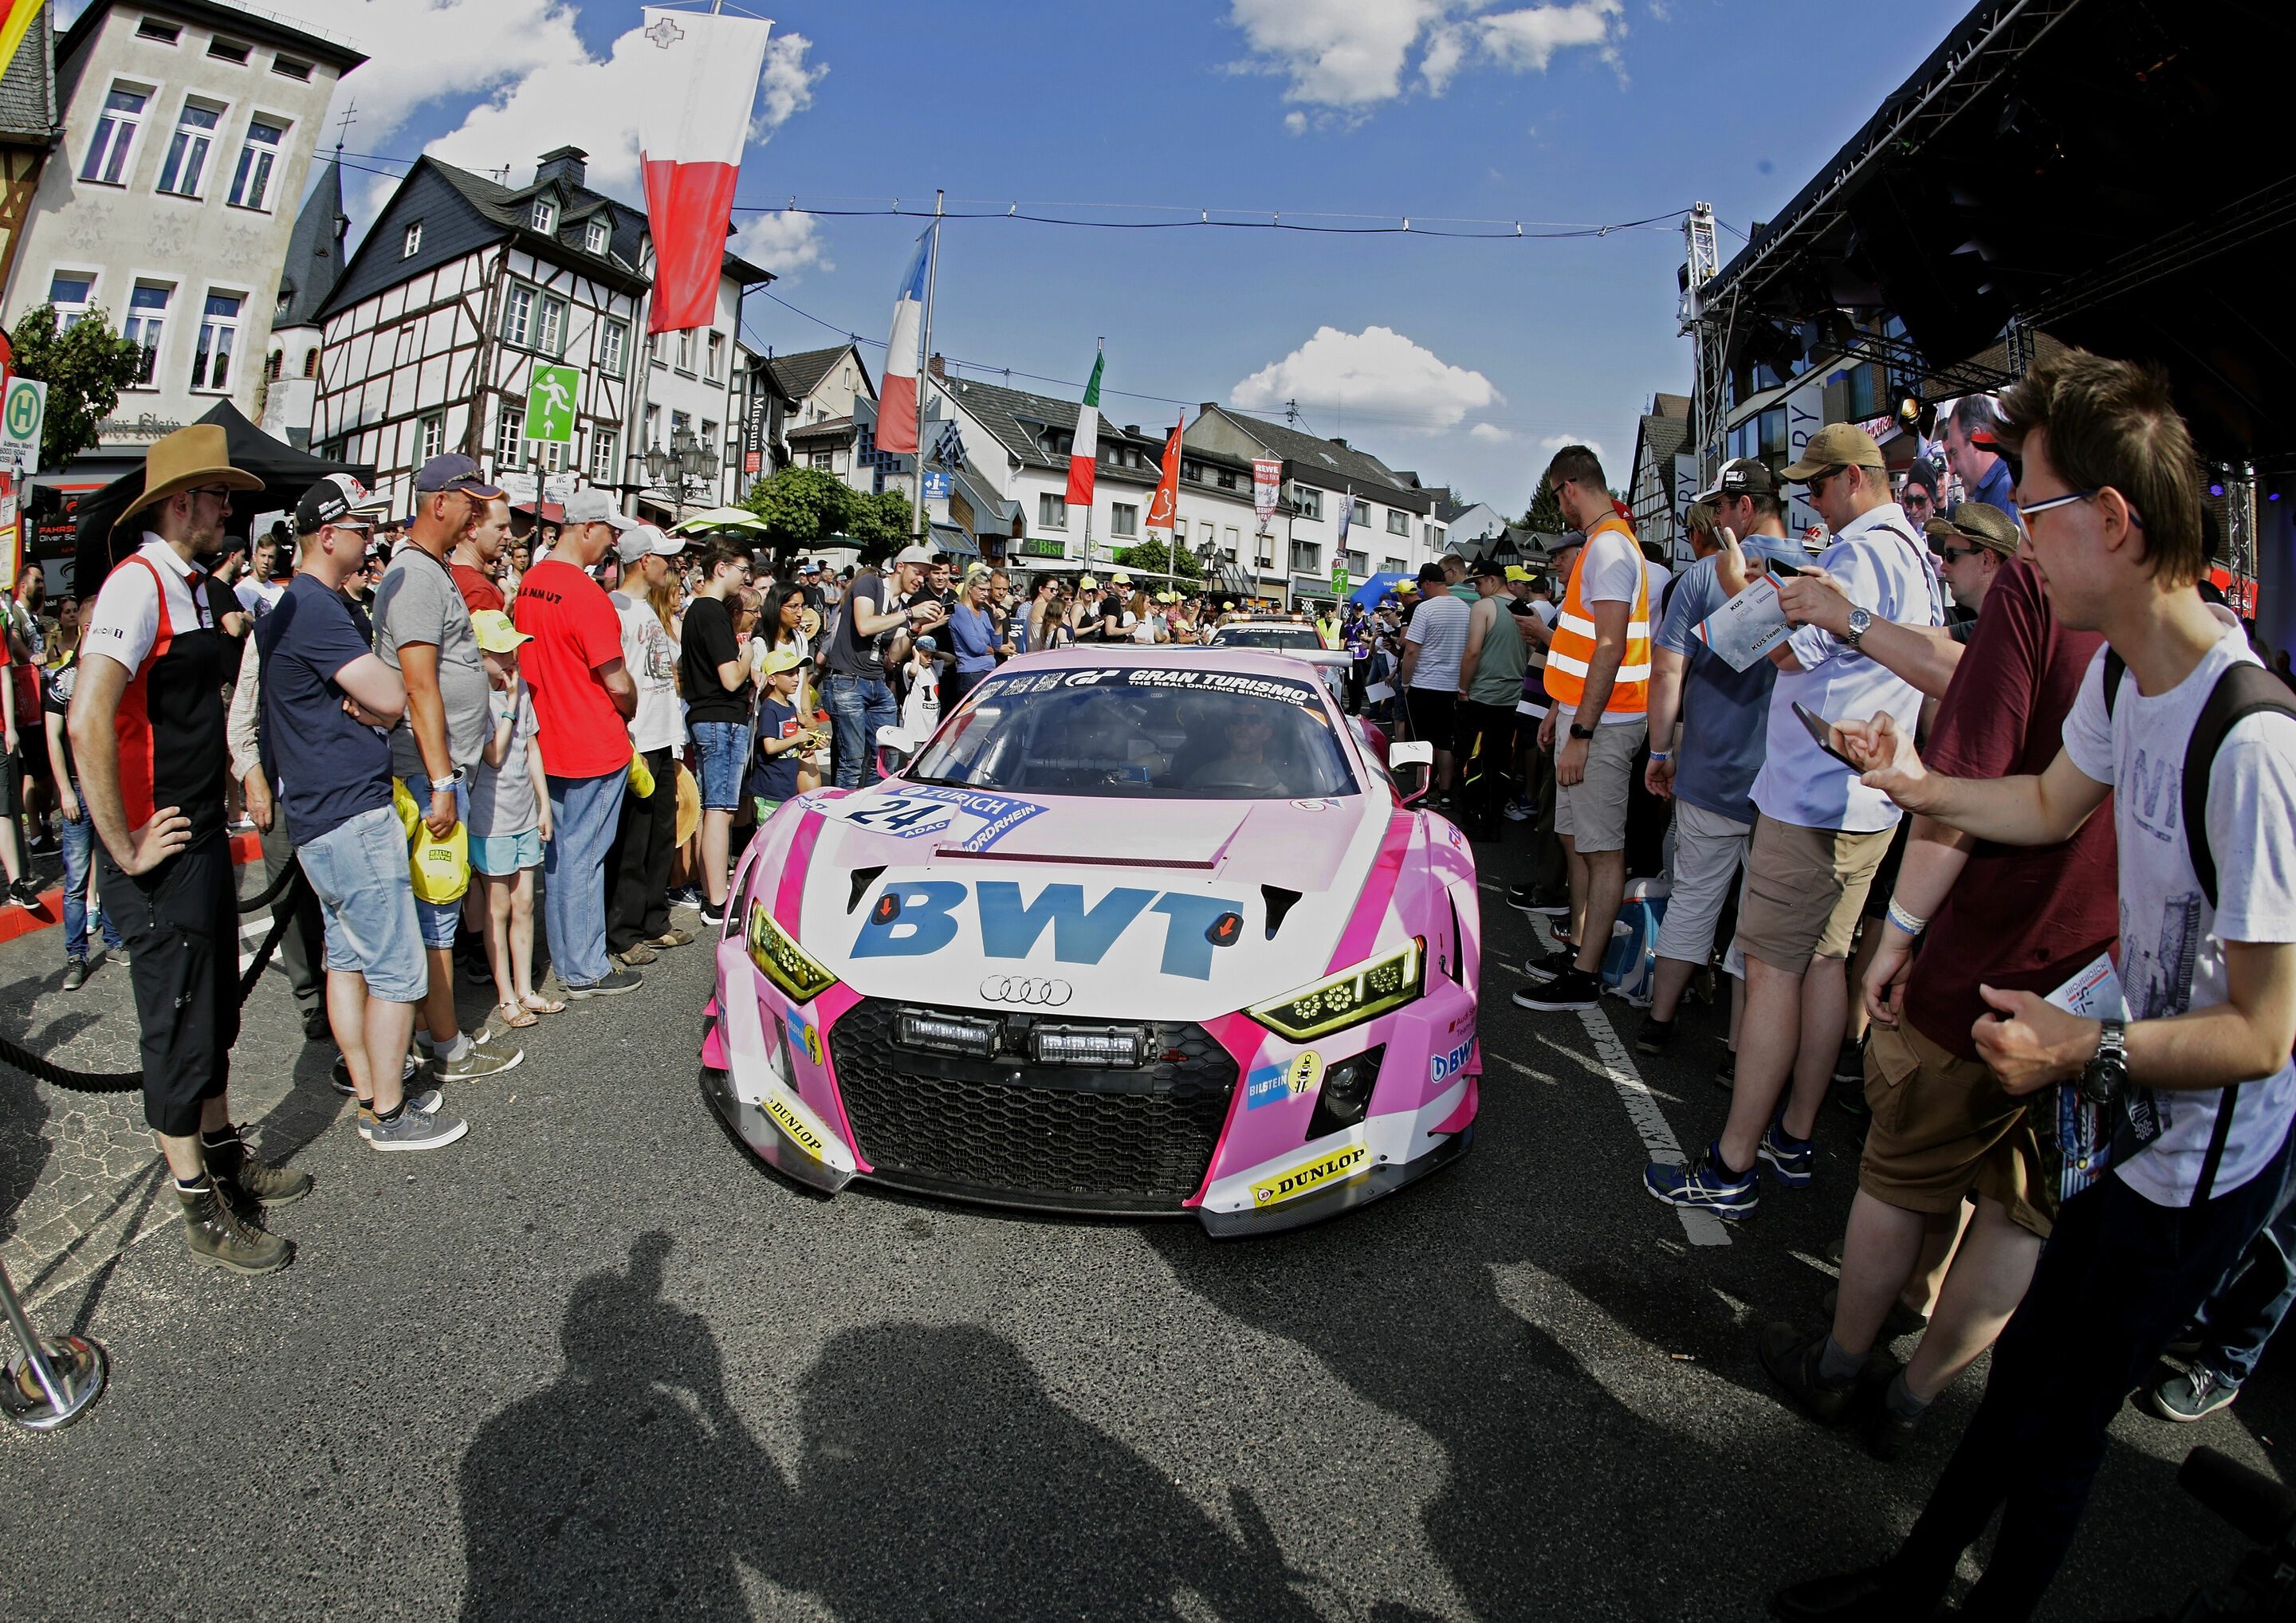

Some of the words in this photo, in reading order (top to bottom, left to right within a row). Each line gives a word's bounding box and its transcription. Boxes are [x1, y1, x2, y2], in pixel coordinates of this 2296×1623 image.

[14, 395, 33, 427] H
[749, 397, 764, 450] Museum
[1255, 464, 1279, 474] REWE
[1767, 628, 1781, 639] Team
[1129, 670, 1199, 682] GRAN
[1202, 674, 1308, 701] TURISMO
[1237, 690, 1304, 706] SIMULATOR
[843, 799, 946, 831] 24
[904, 821, 947, 838] ADAC
[849, 880, 1244, 982] BWT
[2065, 961, 2106, 996] MOTORSPORT
[1456, 1013, 1468, 1027] Audi
[1249, 1074, 1288, 1097] BILSTEIN
[772, 1102, 823, 1149] DUNLOP
[1278, 1149, 1365, 1194] DUNLOP
